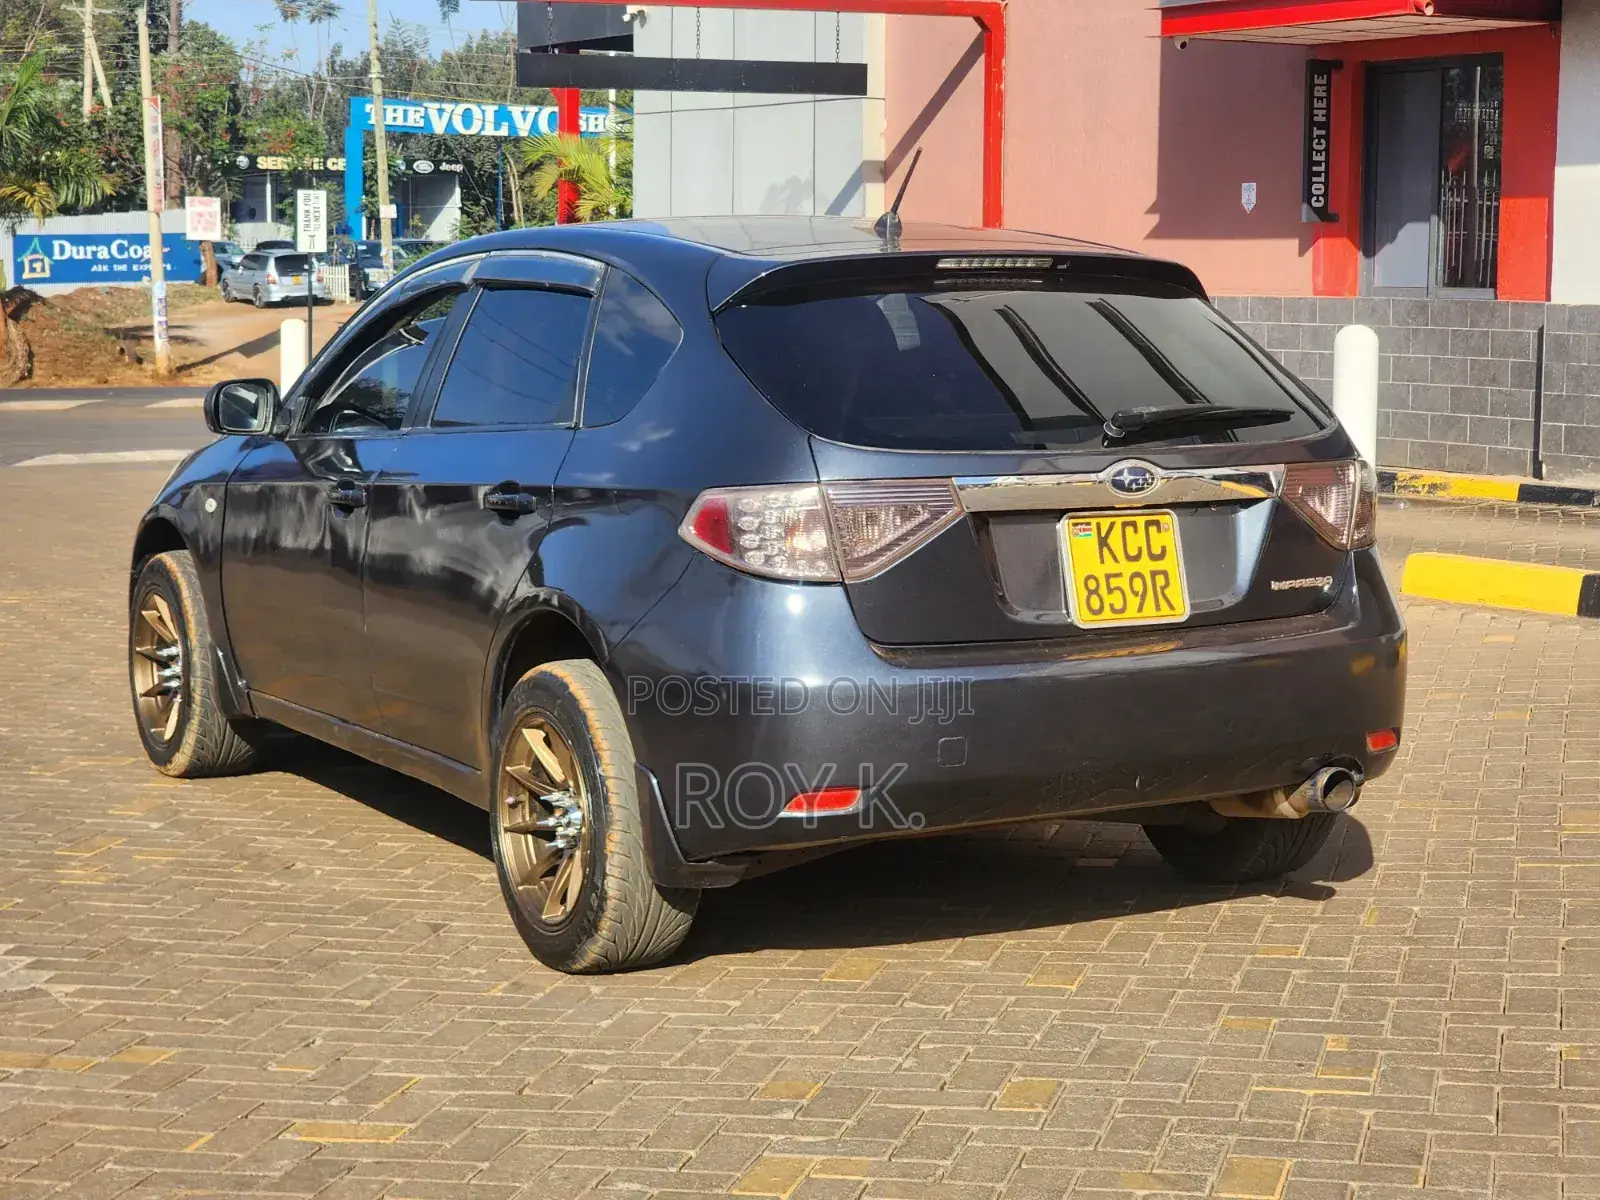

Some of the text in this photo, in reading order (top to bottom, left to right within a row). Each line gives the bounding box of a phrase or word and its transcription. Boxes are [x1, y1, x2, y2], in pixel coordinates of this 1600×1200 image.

[1311, 74, 1328, 208] COLLECT HERE
[439, 161, 464, 172] Jeep
[303, 193, 311, 232] THANK YOU
[1095, 519, 1168, 565] KCC
[1083, 569, 1176, 616] 859R
